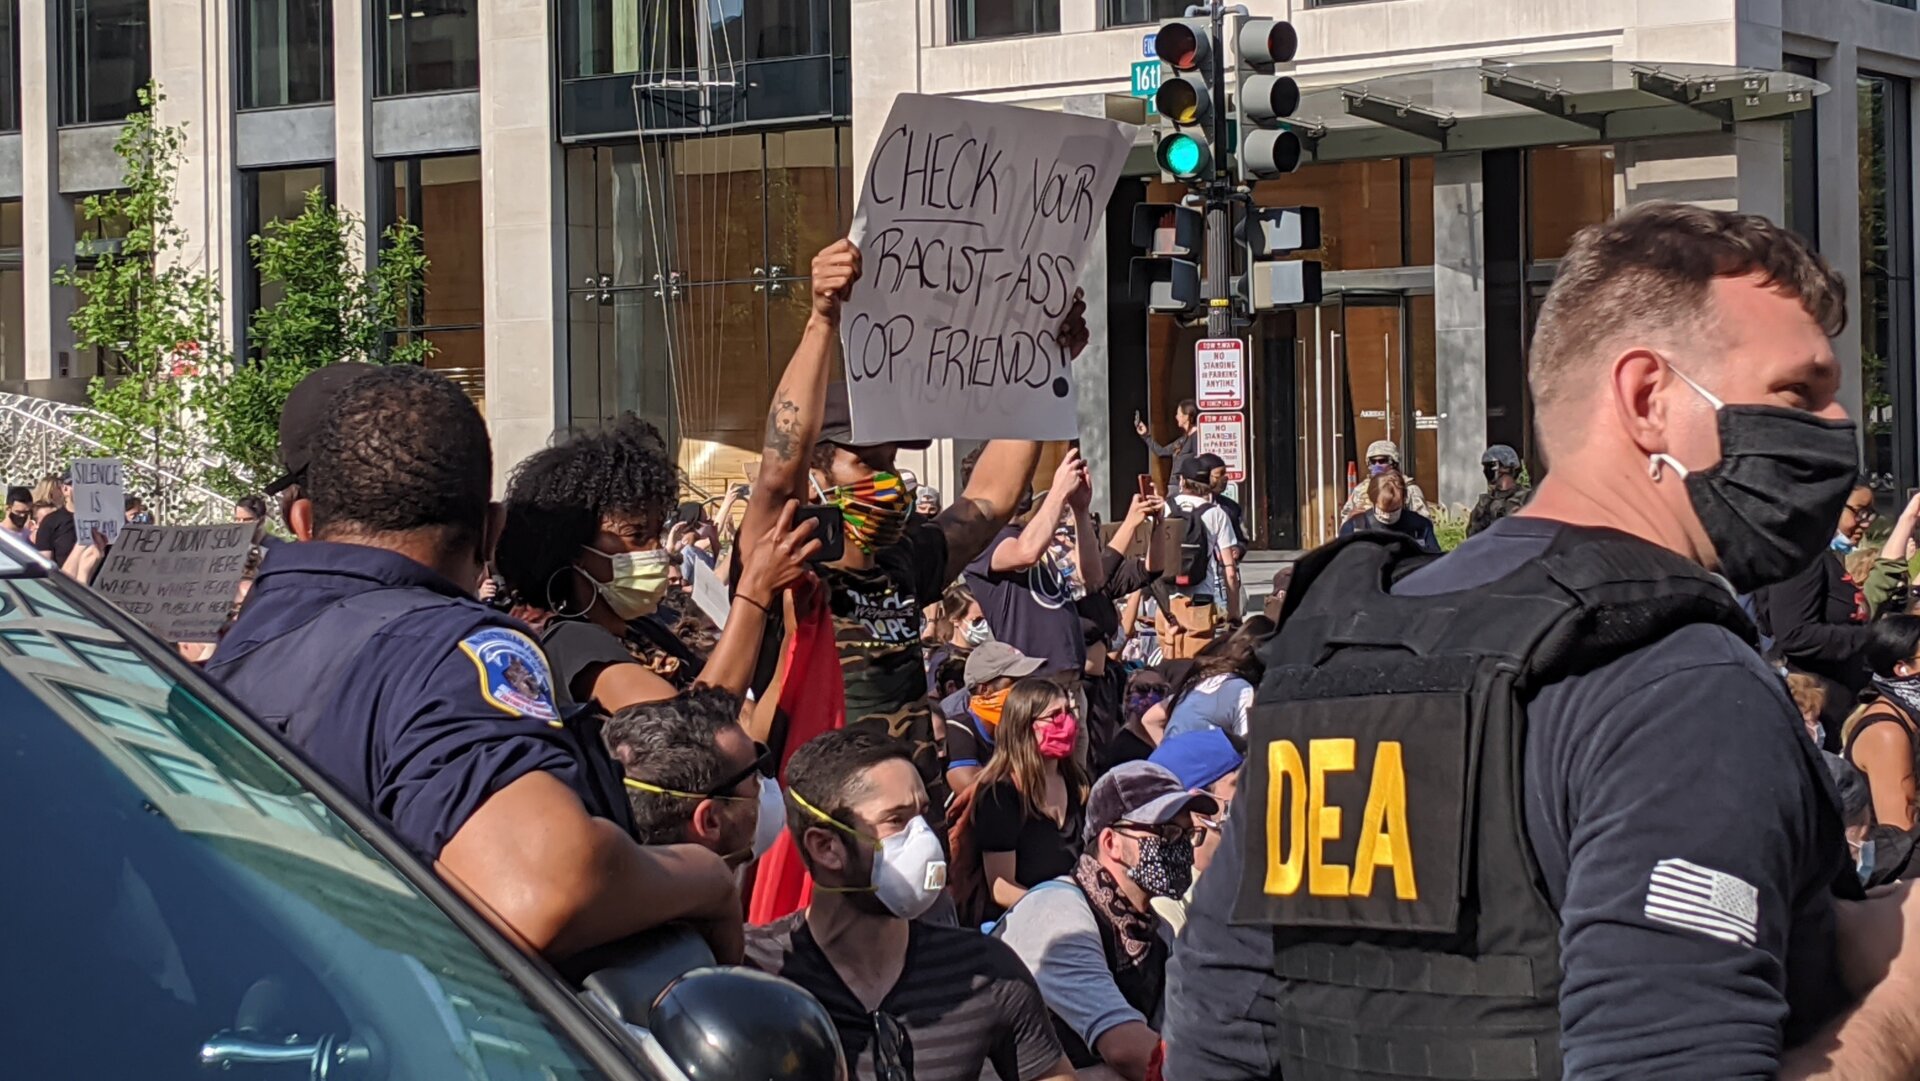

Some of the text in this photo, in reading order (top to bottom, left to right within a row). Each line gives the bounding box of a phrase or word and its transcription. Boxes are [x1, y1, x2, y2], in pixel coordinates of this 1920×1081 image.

[870, 124, 1097, 250] CHECK YOUR
[869, 227, 1076, 319] RACIST-ASS
[849, 312, 1070, 398] COP FRIENDS!
[1203, 361, 1236, 370] STANDING
[1213, 351, 1225, 360] NO
[1206, 379, 1236, 388] ANYTIME
[1208, 370, 1238, 379] PARKING
[1204, 432, 1238, 440] STANDING
[74, 462, 120, 486] SILENCE
[90, 491, 102, 513] IS
[120, 527, 168, 553] THEY
[210, 526, 242, 549] SEND
[110, 555, 144, 574] THE
[208, 554, 242, 574] HERE
[99, 577, 150, 596] WHEN
[157, 580, 200, 598] WHITE
[160, 601, 205, 616] PUBLIC
[1263, 738, 1418, 900] DEA
